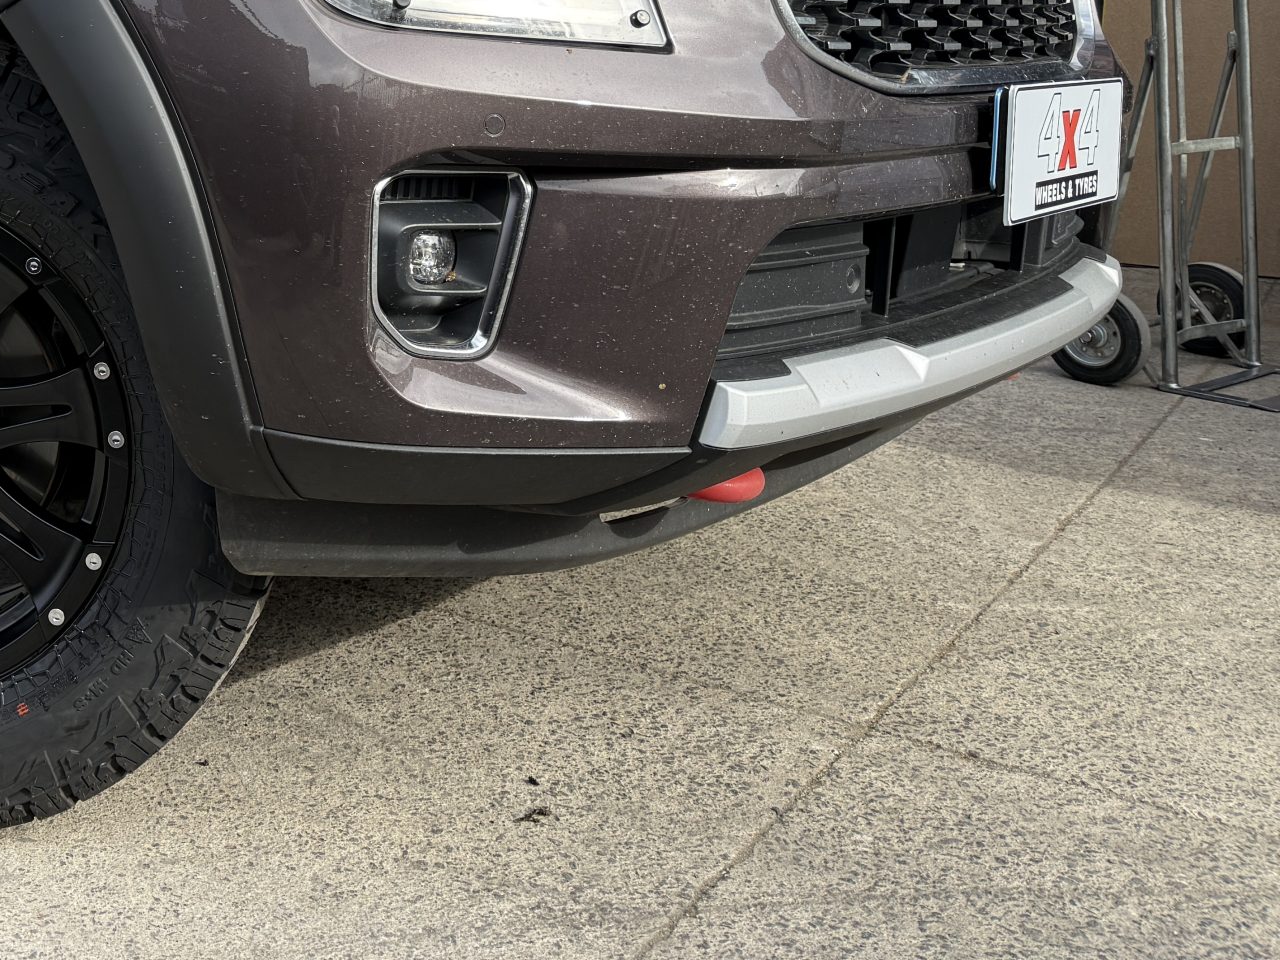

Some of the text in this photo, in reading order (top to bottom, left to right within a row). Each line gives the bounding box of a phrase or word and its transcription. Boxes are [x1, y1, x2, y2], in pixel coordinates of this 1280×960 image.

[1035, 174, 1098, 206] WHEELS & TYRES
